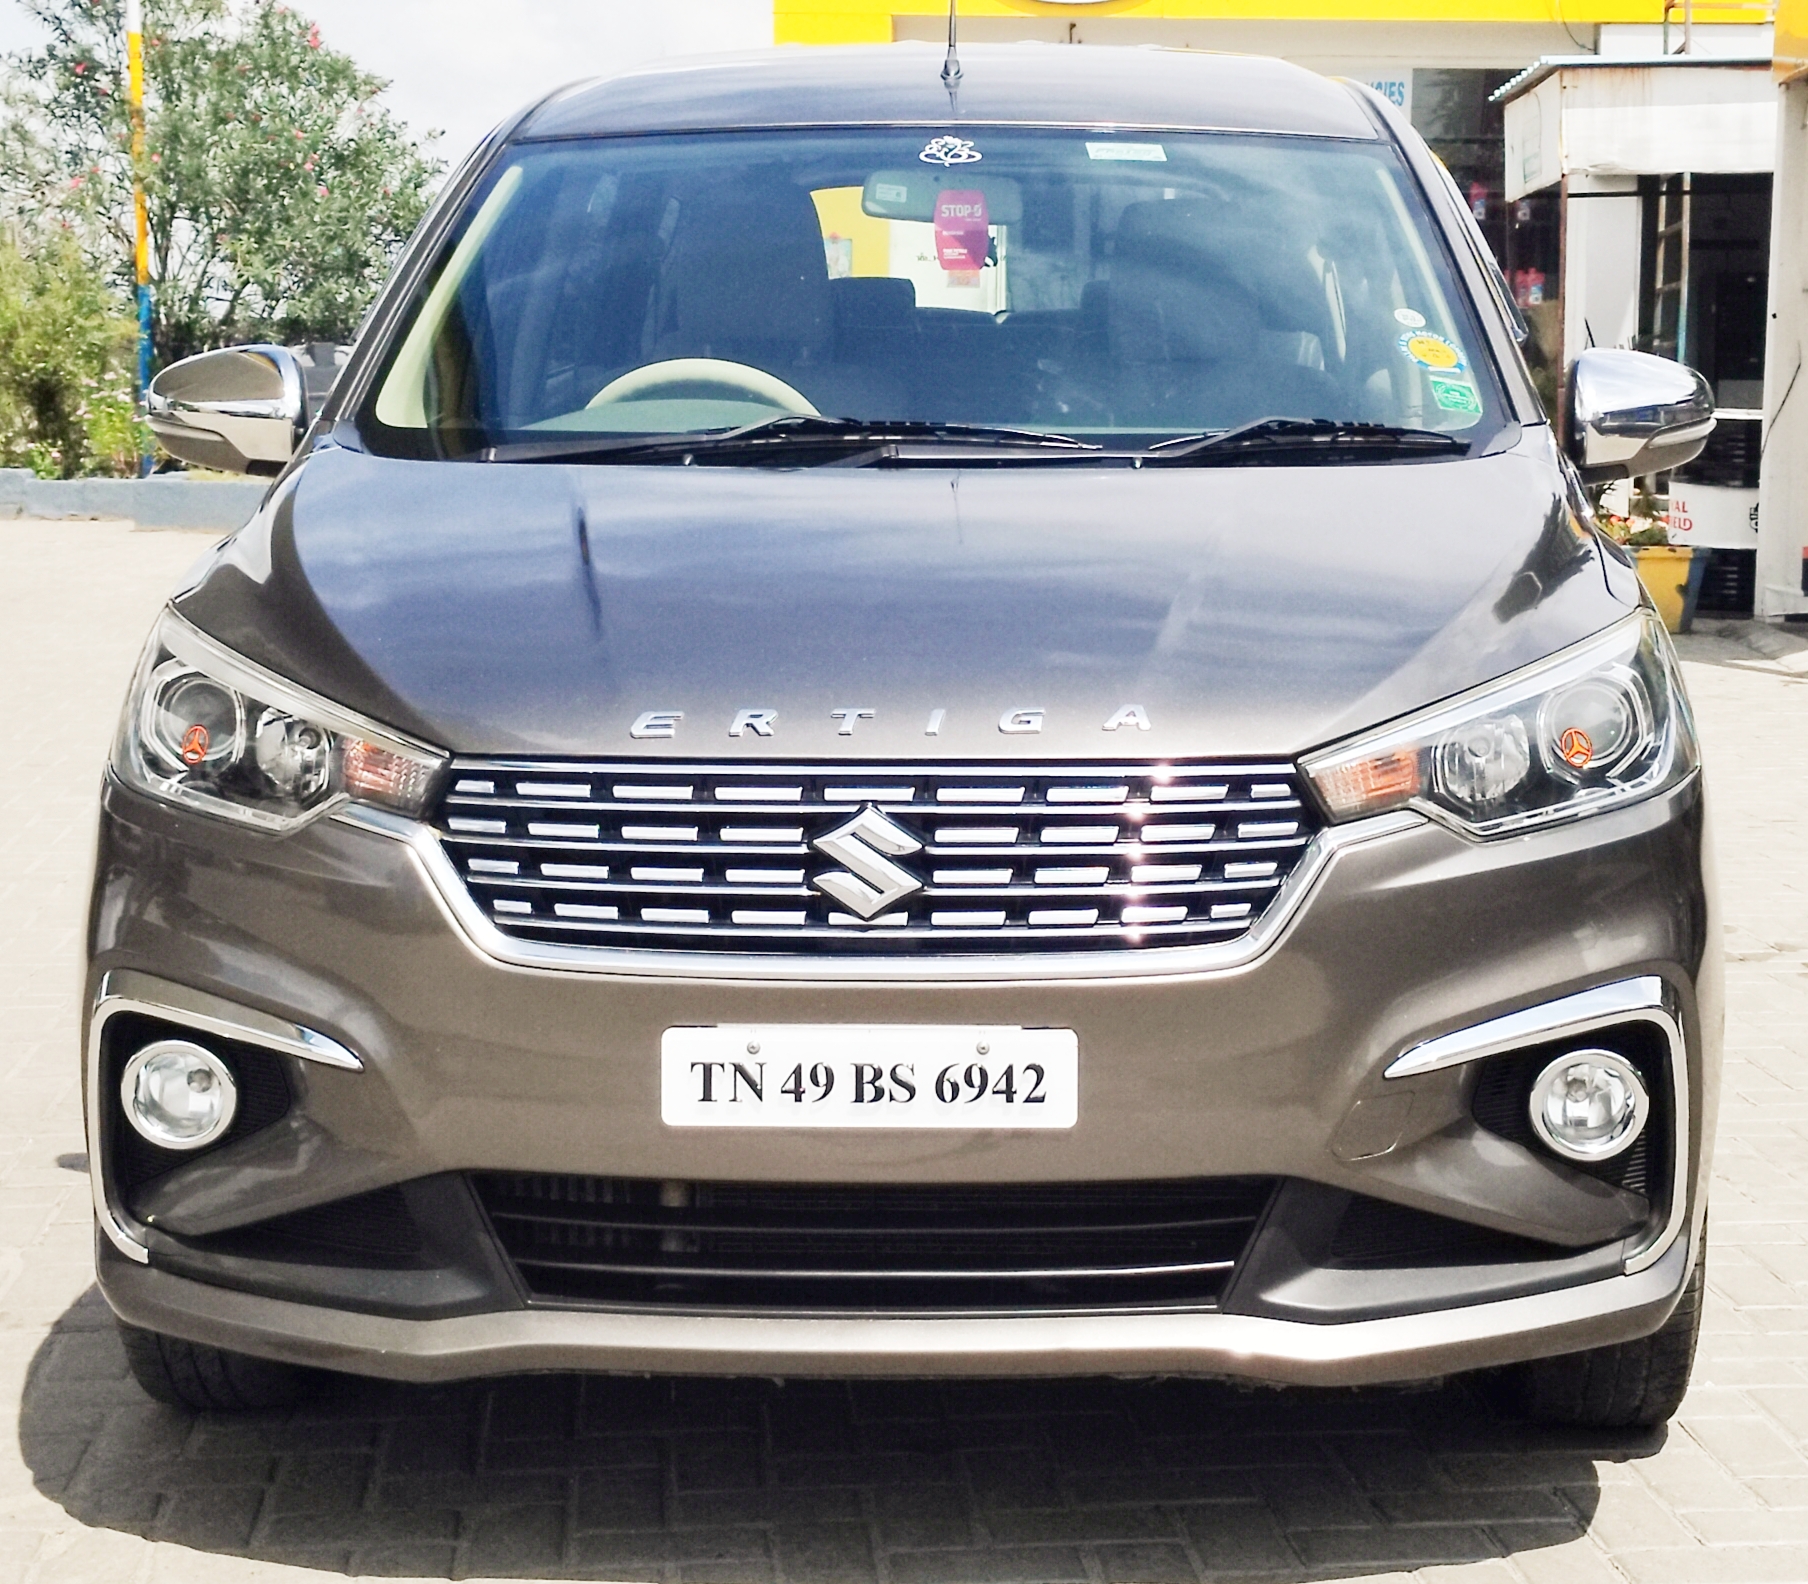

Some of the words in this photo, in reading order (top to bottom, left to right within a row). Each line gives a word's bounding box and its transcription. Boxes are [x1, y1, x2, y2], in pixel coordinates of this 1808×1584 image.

[630, 703, 1152, 739] ERTIGA
[690, 1061, 767, 1103] TN
[780, 1062, 835, 1103] 49
[850, 1062, 917, 1104] BS
[935, 1062, 1048, 1104] 6942
